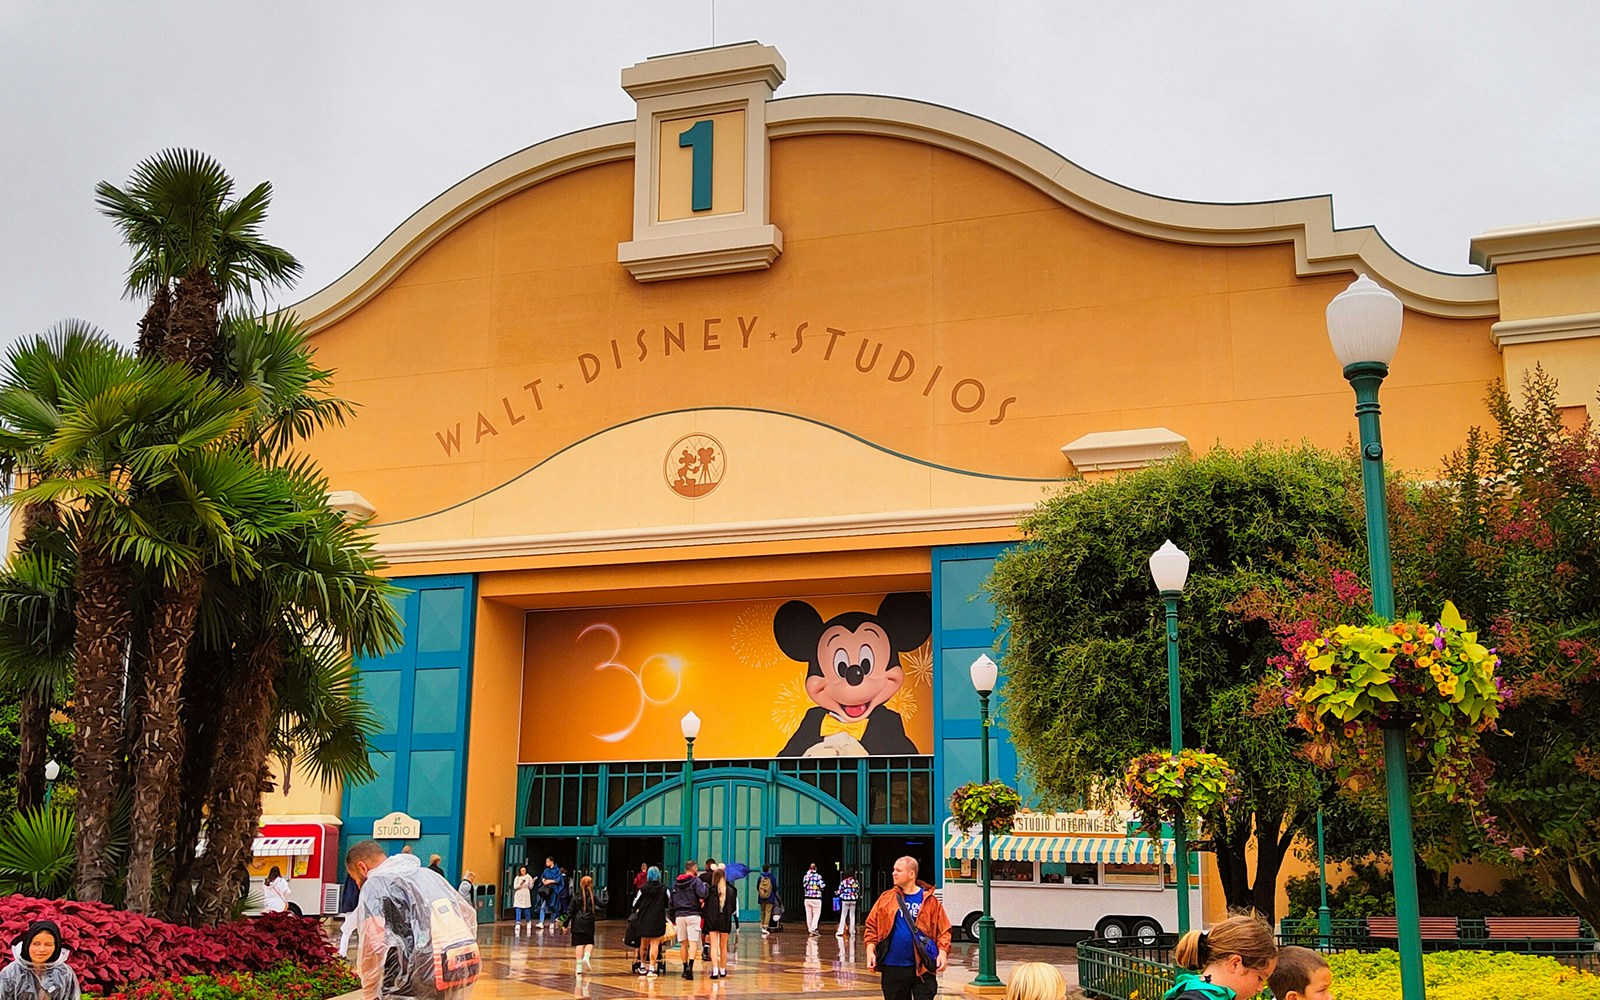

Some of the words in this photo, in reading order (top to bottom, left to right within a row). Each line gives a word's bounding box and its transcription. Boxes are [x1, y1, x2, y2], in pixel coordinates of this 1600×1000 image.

[678, 119, 713, 212] 1
[435, 378, 544, 458] WALT
[577, 316, 759, 384] DISNEY
[791, 322, 1017, 426] STUDIOS
[575, 622, 684, 743] 30
[377, 826, 410, 836] STUDIO
[1018, 817, 1050, 831] STUDIO
